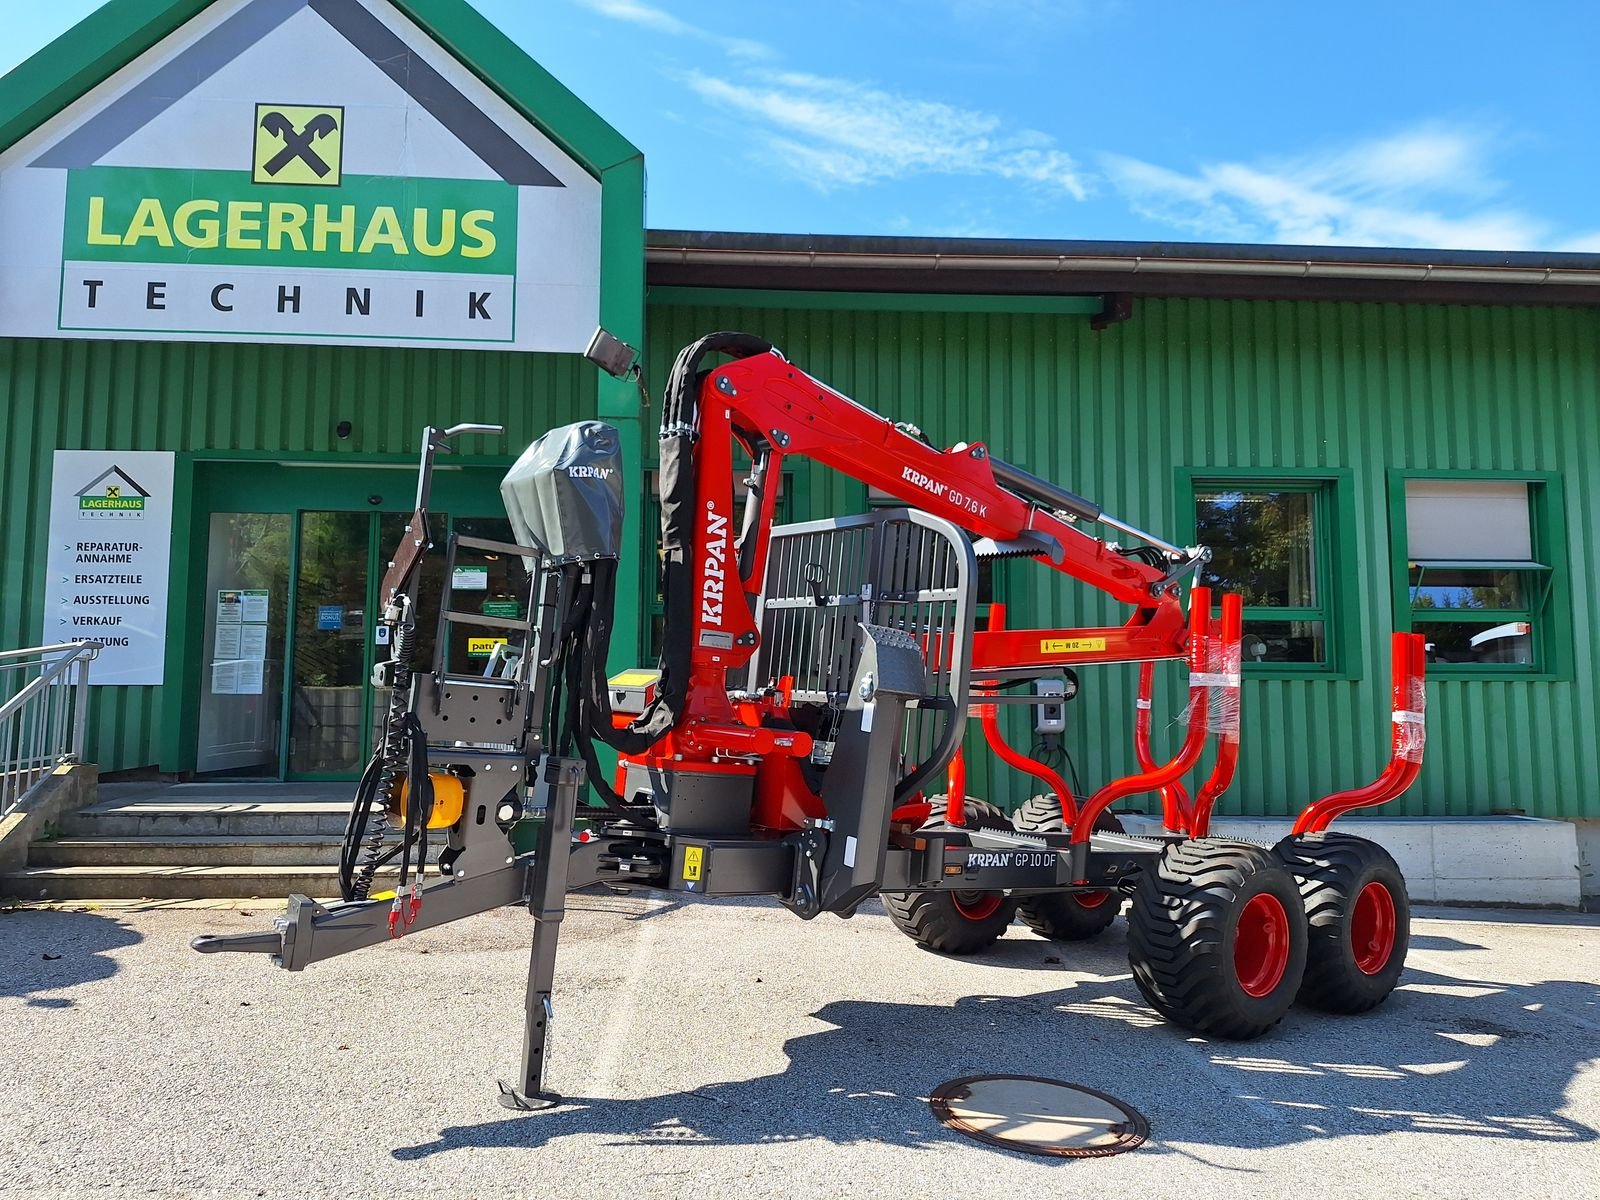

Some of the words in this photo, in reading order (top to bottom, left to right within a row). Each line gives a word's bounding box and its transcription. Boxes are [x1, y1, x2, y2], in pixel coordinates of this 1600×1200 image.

[86, 196, 497, 259] LAGERHAUS
[83, 280, 492, 320] TECHNIK
[82, 500, 142, 508] LAGERHAUS
[948, 490, 963, 506] GD
[964, 497, 978, 514] 7,6
[979, 504, 987, 518] K
[76, 542, 143, 552] REPARATUR-
[76, 554, 132, 563] ANNAHME
[74, 574, 143, 584] ERSATZTEILE
[73, 595, 150, 605] AUSSTELLUNG
[72, 616, 122, 626] VERKAUF
[472, 643, 495, 651] patu
[1015, 853, 1028, 866] GP
[1030, 853, 1041, 866] 10
[1043, 853, 1056, 867] DF
